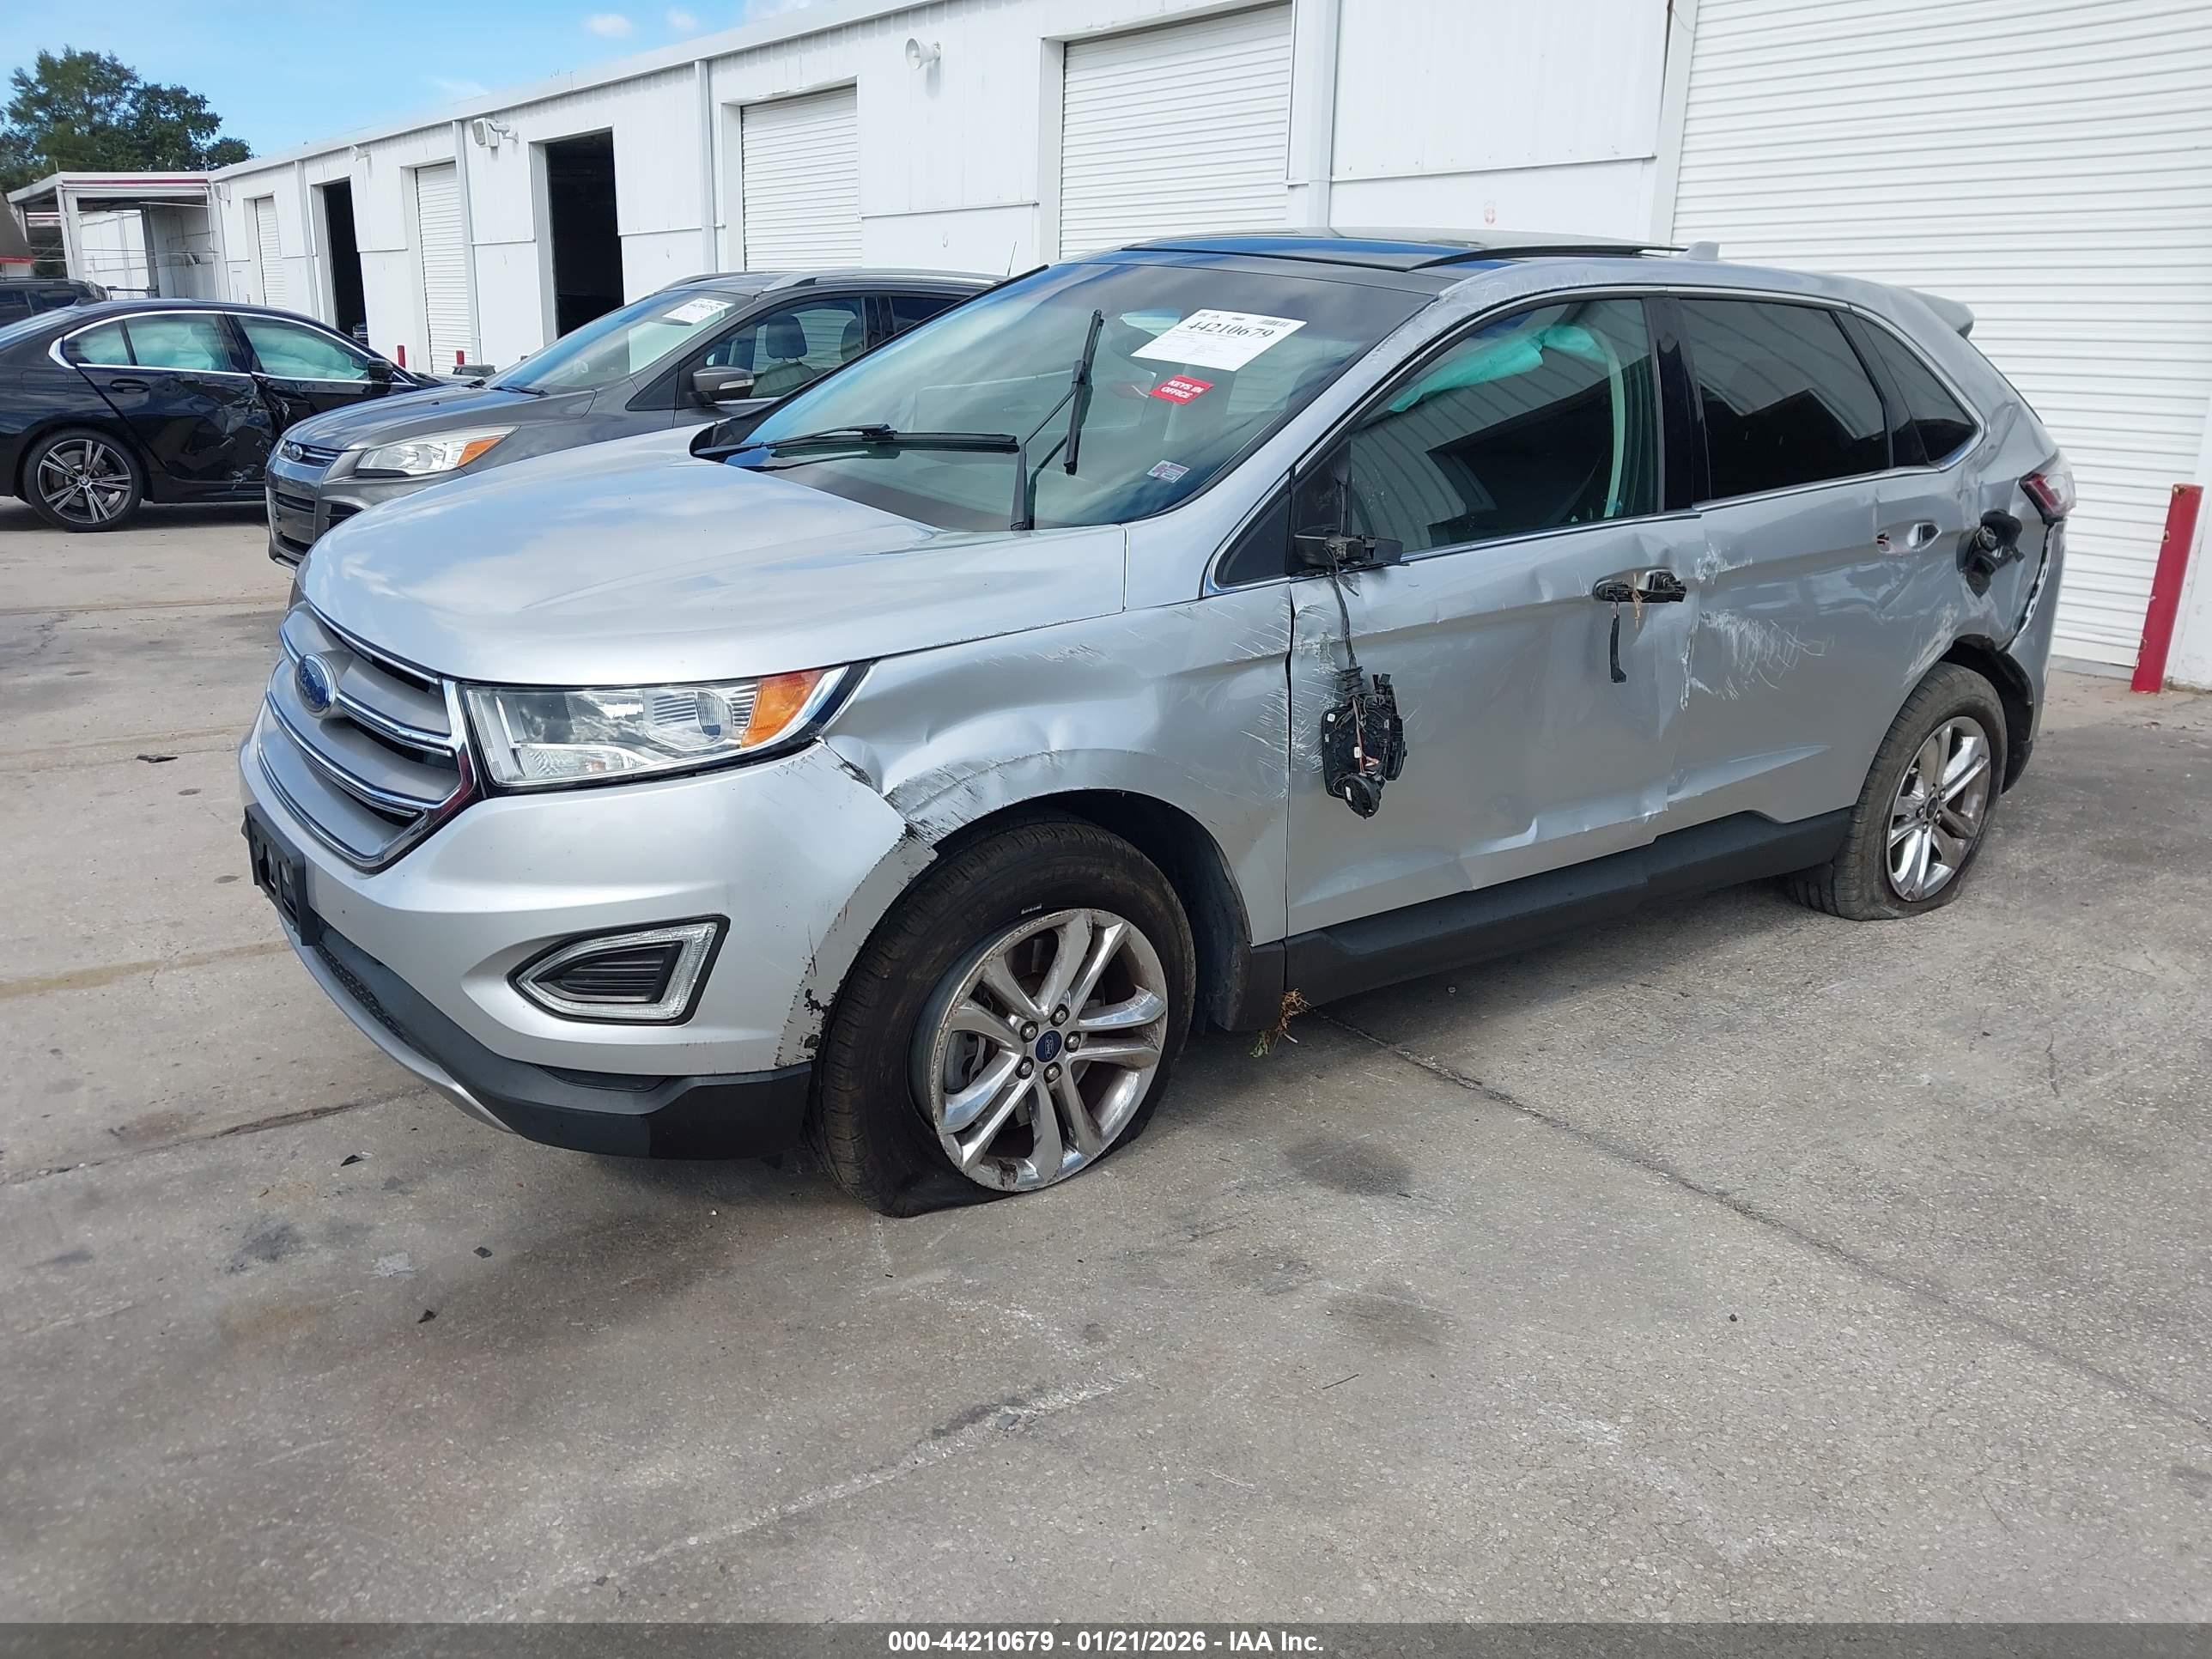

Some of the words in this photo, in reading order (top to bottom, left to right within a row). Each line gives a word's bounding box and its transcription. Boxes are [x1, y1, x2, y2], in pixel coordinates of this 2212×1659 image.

[1188, 321, 1275, 338] 44210679
[1167, 380, 1193, 391] KEYS
[1161, 386, 1193, 398] OFFICE
